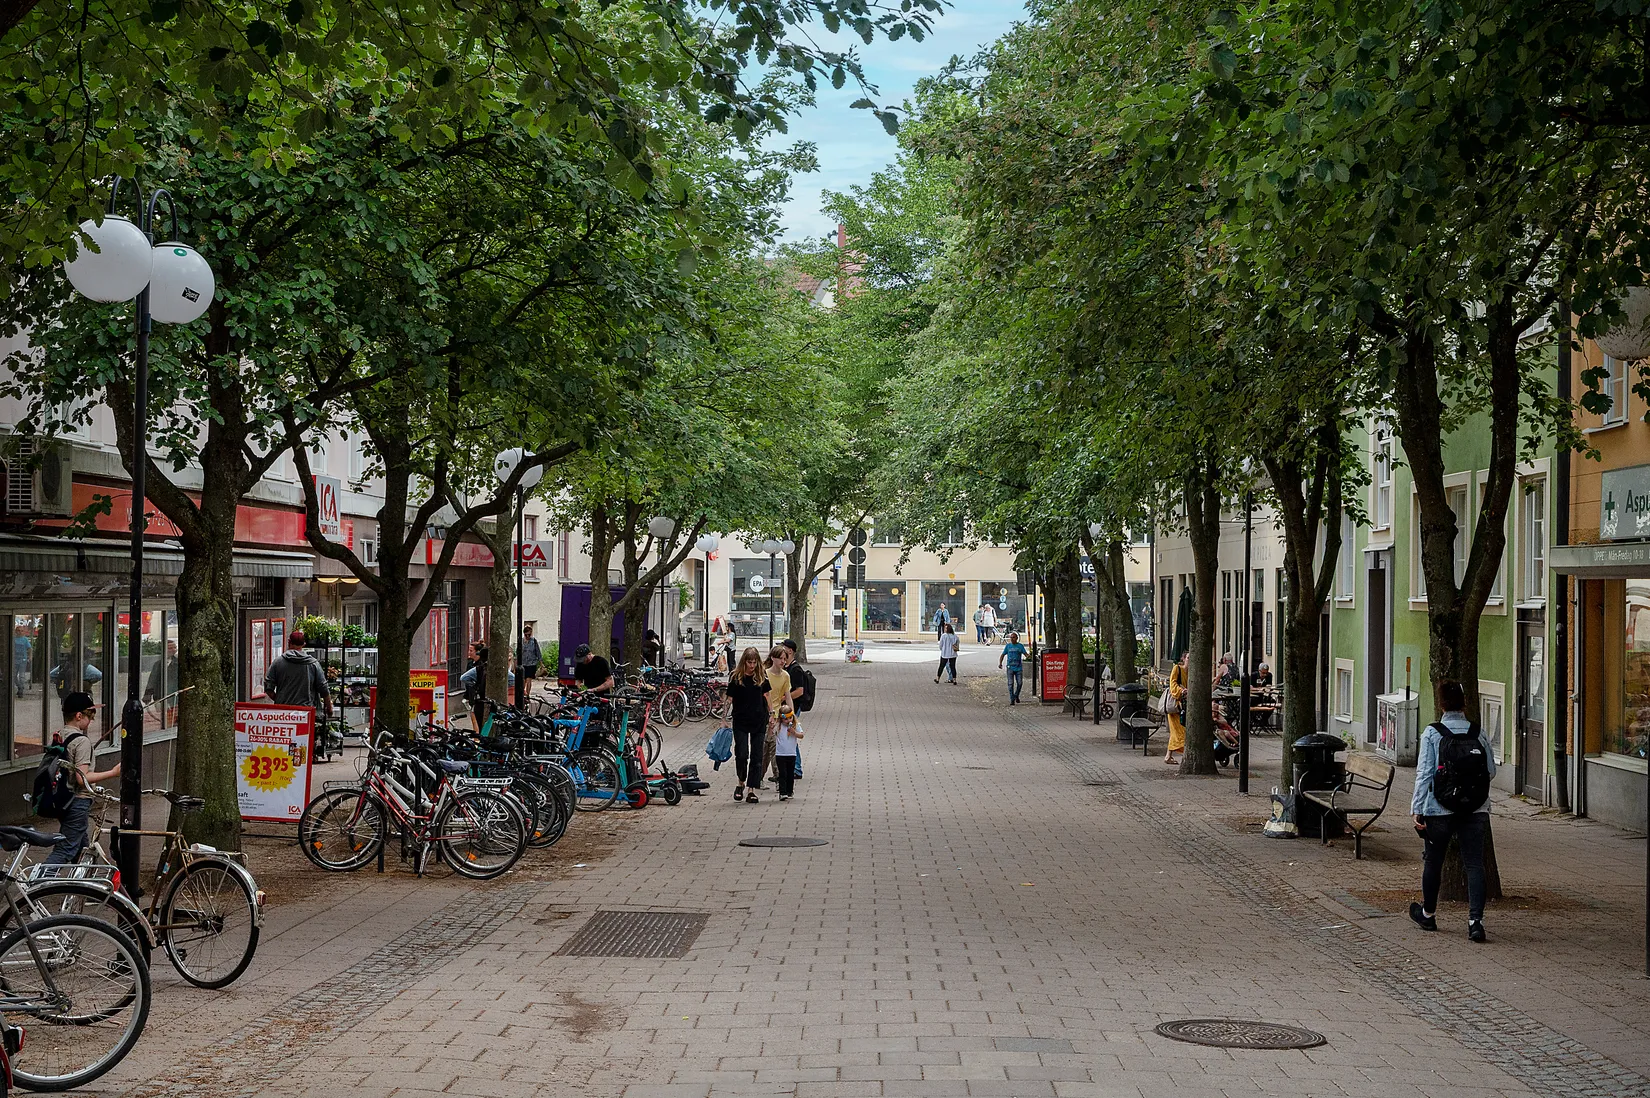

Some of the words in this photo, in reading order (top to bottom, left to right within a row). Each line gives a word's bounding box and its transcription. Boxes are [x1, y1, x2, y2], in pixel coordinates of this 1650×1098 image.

[320, 483, 338, 521] ICA
[513, 544, 547, 561] ICA
[238, 712, 254, 721] ICA
[256, 712, 306, 723] Aspudden-
[248, 724, 293, 737] KLIPPET
[288, 805, 301, 813] ICA
